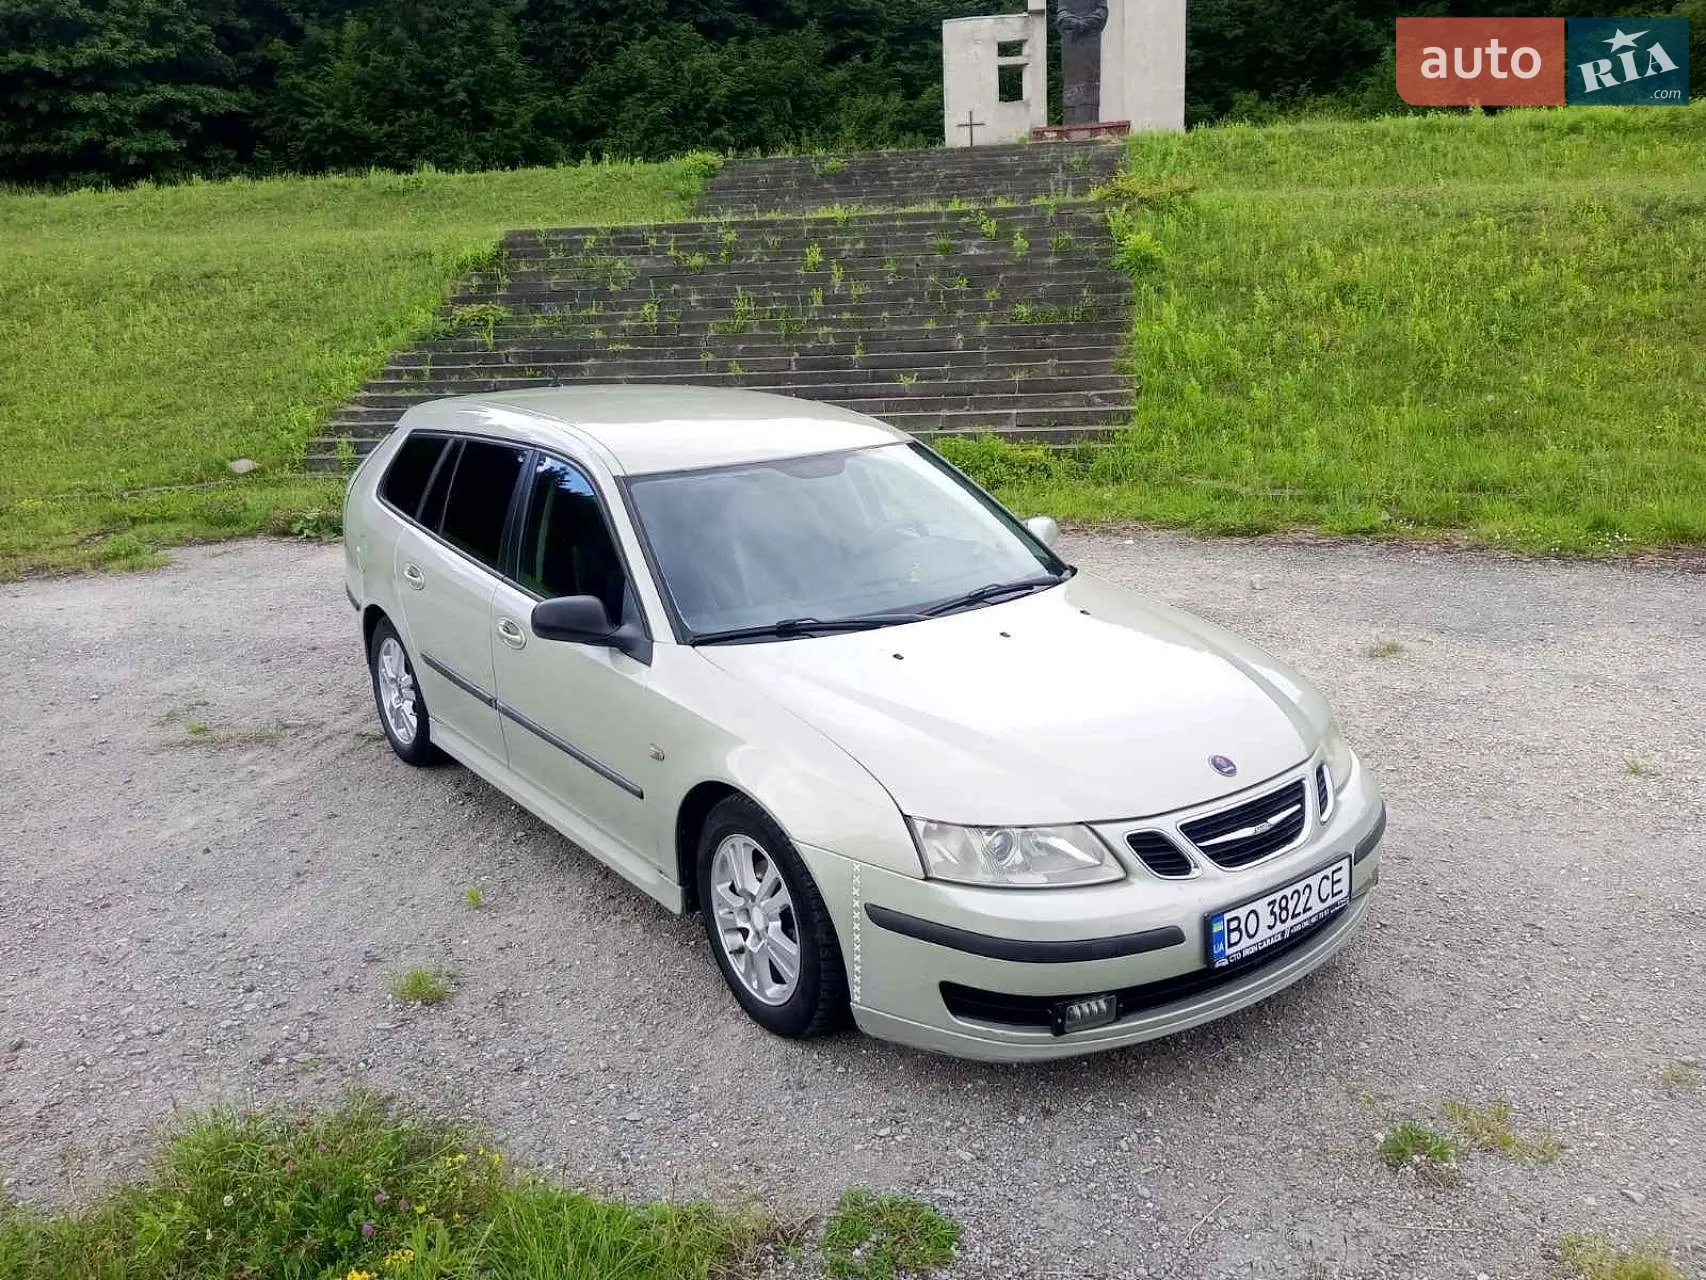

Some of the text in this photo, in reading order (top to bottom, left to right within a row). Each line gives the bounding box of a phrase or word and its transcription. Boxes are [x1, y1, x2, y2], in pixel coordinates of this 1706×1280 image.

[1226, 910, 1259, 949] BO
[1267, 884, 1312, 930] 3822
[1318, 866, 1343, 904] CE
[1213, 942, 1224, 954] UA
